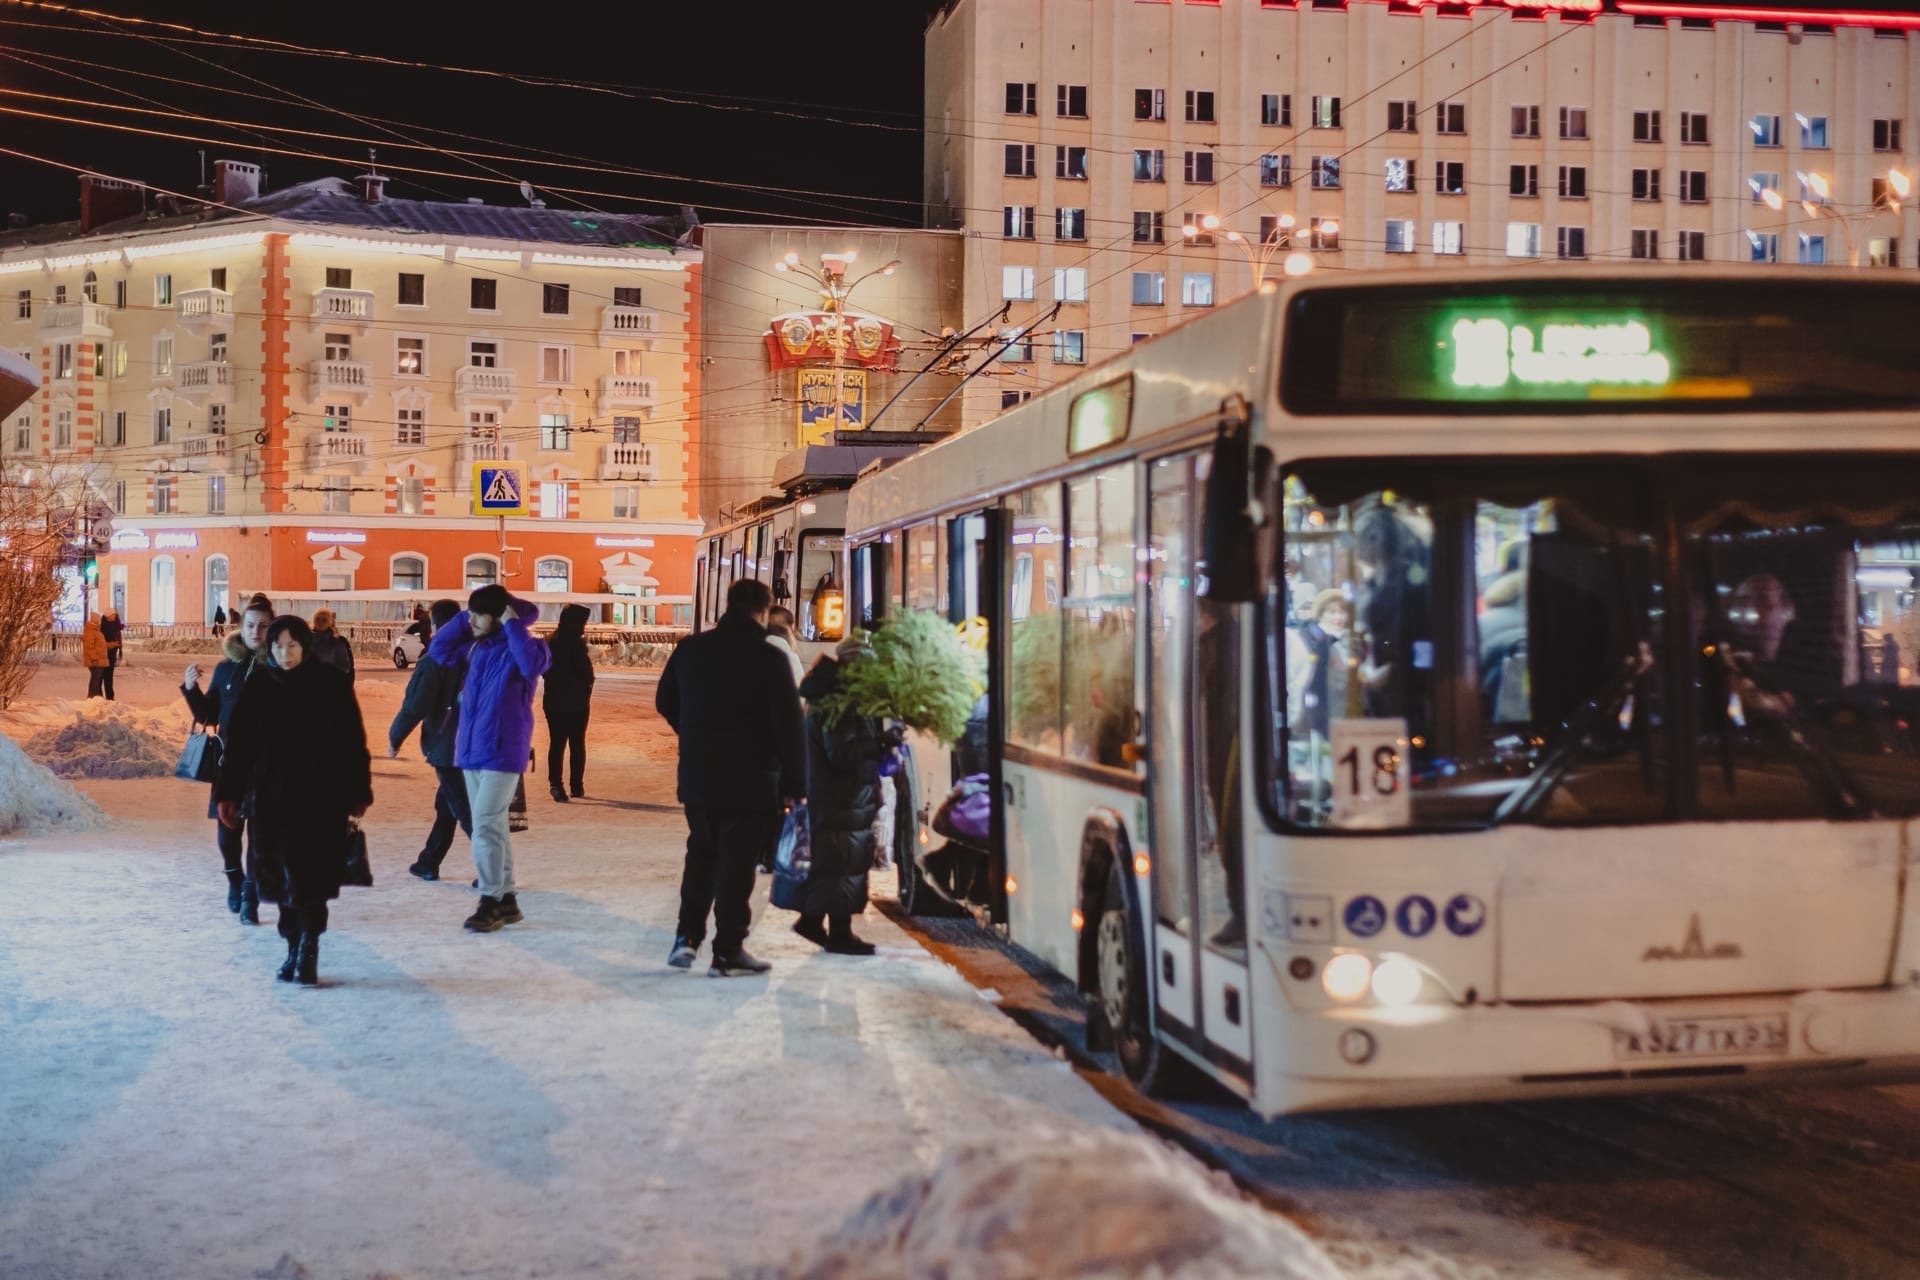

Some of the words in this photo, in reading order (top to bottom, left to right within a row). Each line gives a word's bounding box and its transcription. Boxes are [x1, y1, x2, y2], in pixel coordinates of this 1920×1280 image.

[802, 374, 863, 387] МУРМНСК
[96, 528, 110, 537] 40
[823, 596, 843, 629] 6
[1338, 745, 1399, 797] 18
